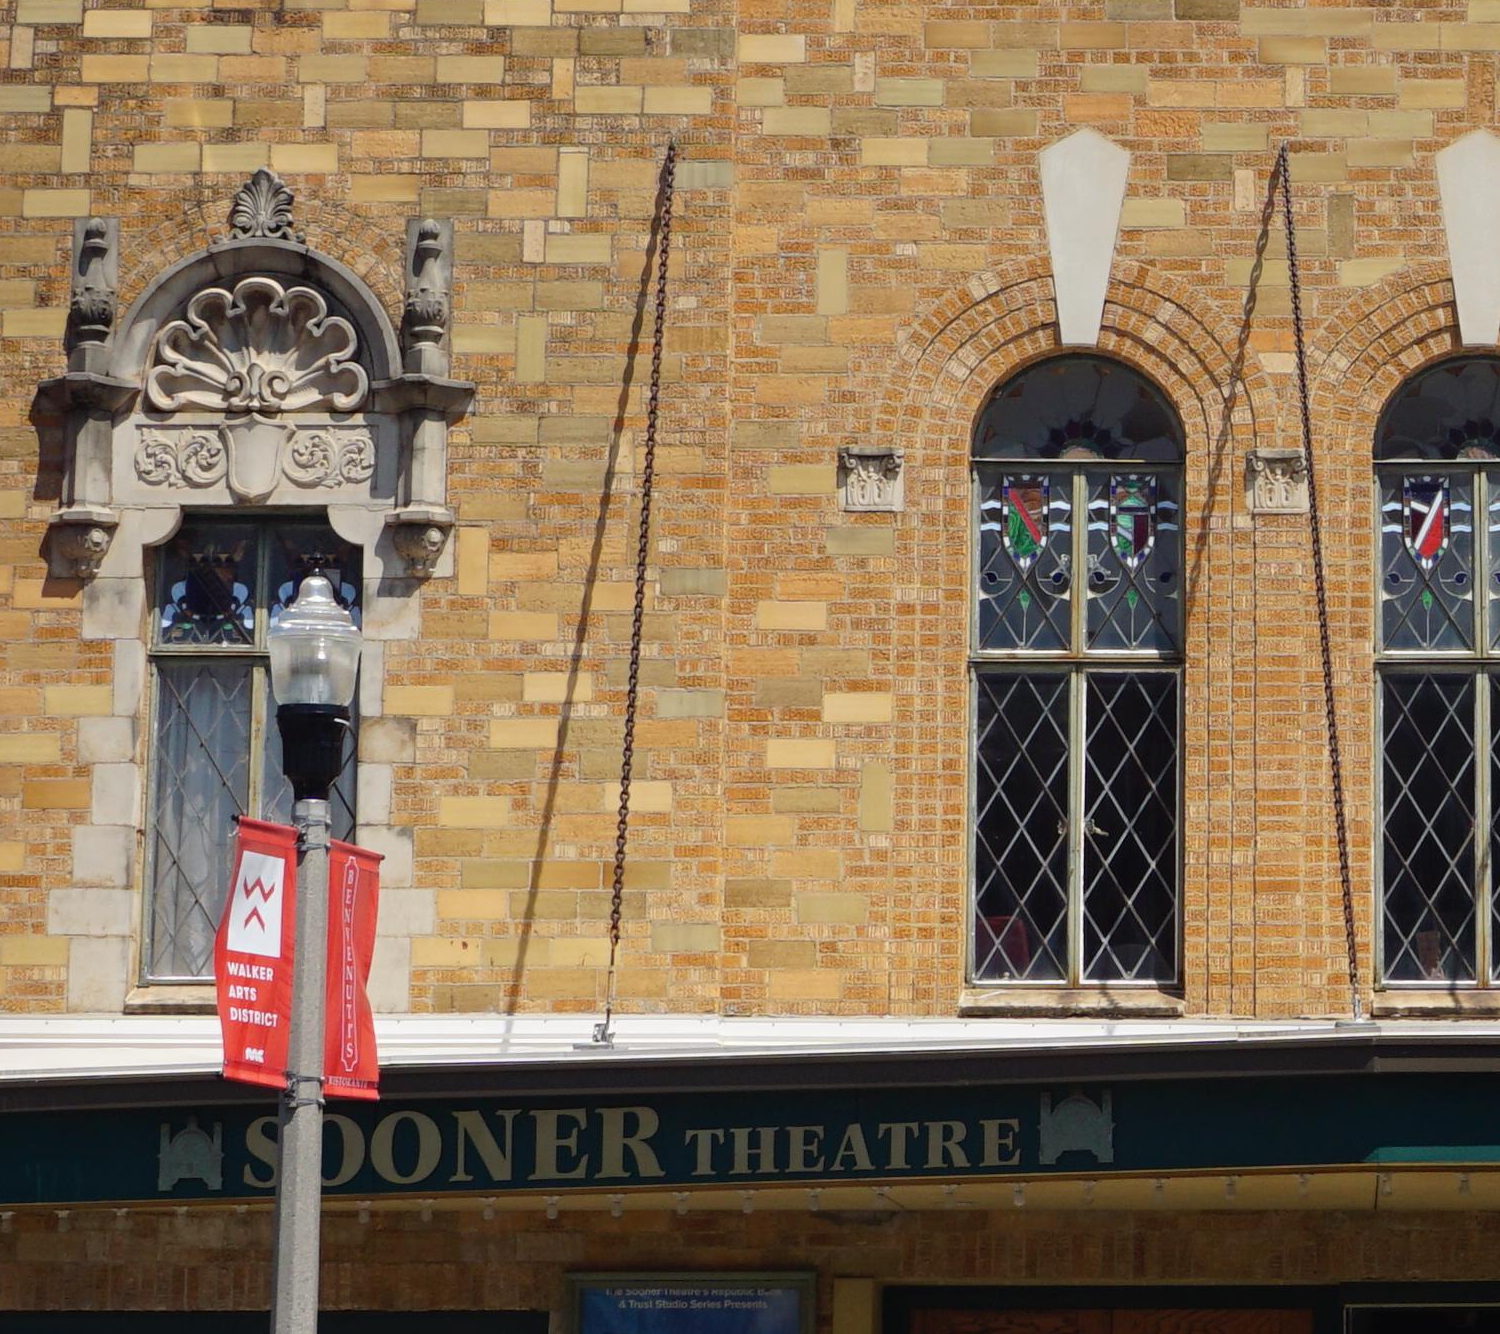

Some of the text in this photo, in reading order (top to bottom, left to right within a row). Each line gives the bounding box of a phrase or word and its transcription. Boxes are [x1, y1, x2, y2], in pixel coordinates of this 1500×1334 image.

[227, 961, 274, 982] WALKER
[228, 985, 257, 1001] ARTS
[230, 1007, 278, 1028] DISTRICT
[244, 1104, 1022, 1189] SOONER THEATRE
[628, 1299, 653, 1309] Trust
[655, 1299, 688, 1309] Studio
[690, 1299, 721, 1309] Series
[724, 1299, 768, 1309] Presents
